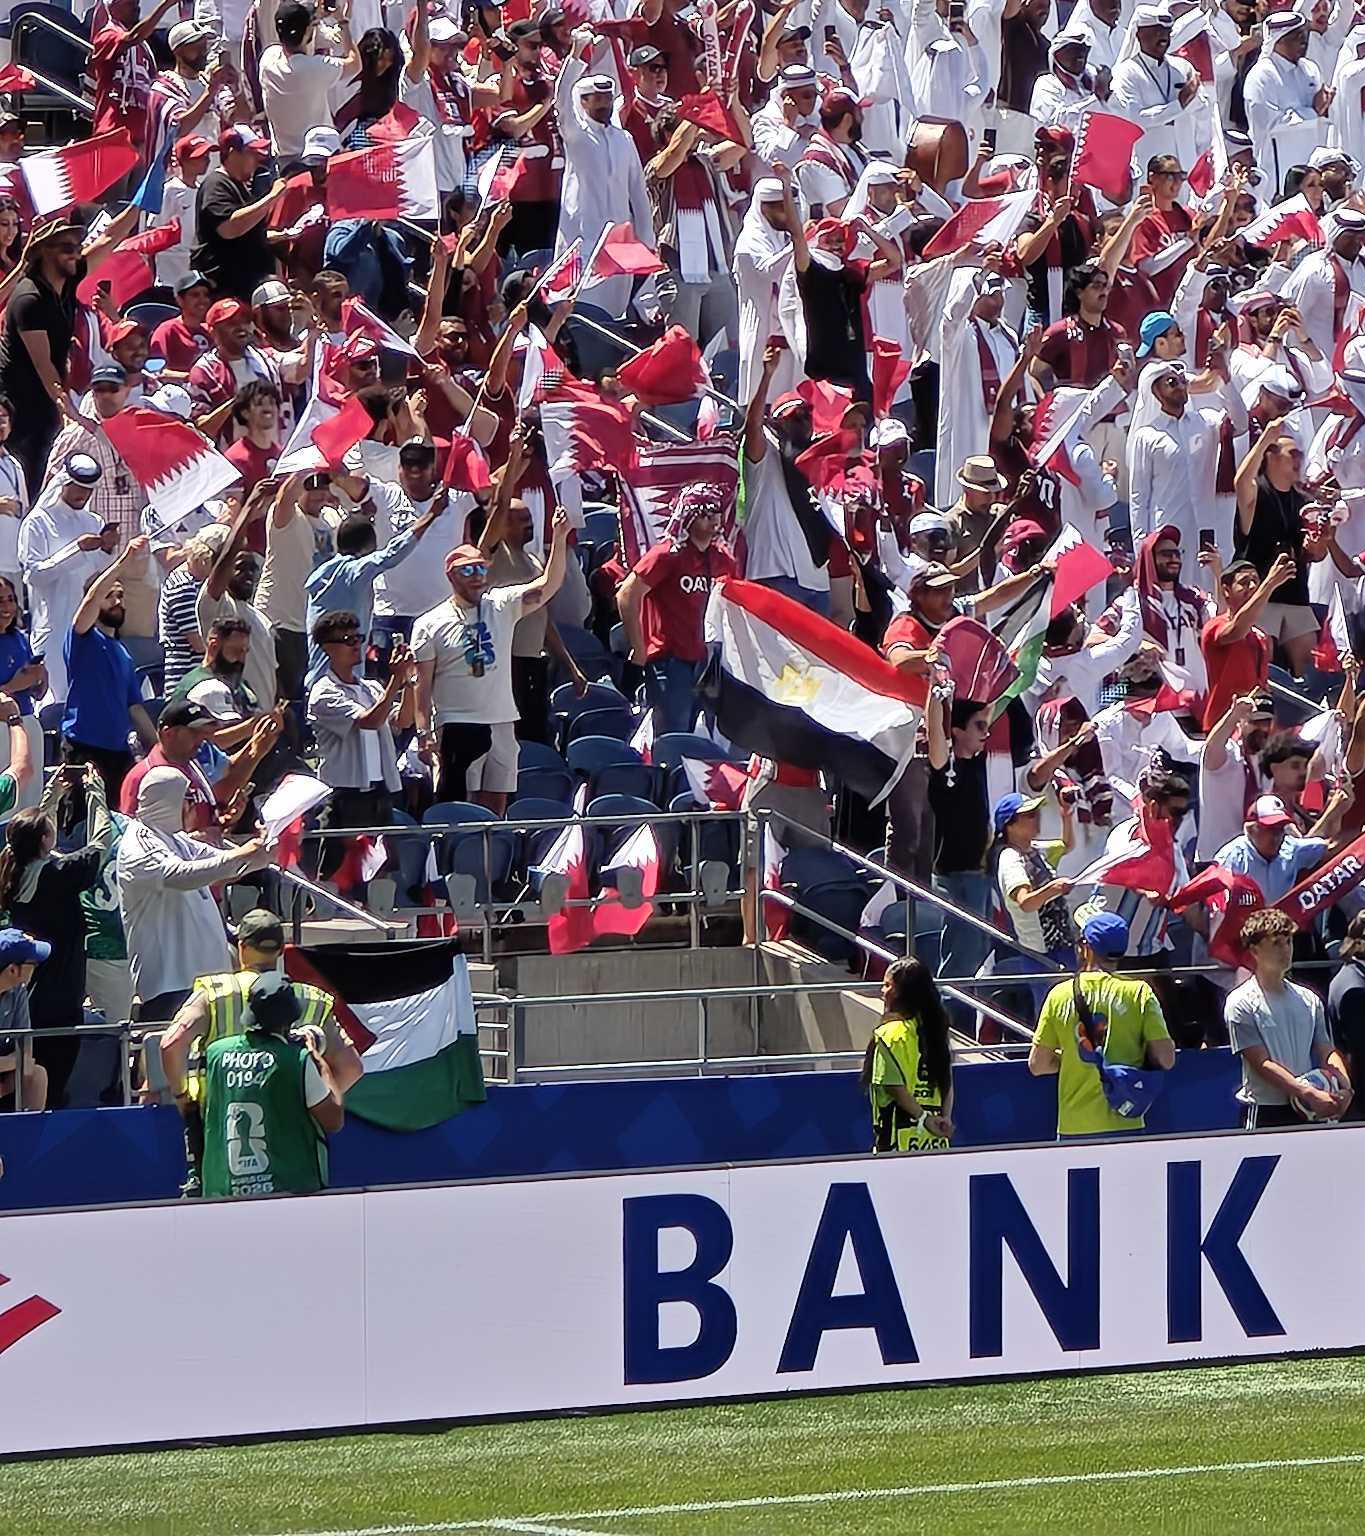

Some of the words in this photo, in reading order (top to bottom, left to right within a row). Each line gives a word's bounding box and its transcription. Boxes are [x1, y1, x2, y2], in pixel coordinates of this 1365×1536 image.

[1299, 855, 1362, 913] QATAR
[221, 1051, 276, 1070] PHOTO
[624, 1156, 1285, 1381] BANK
